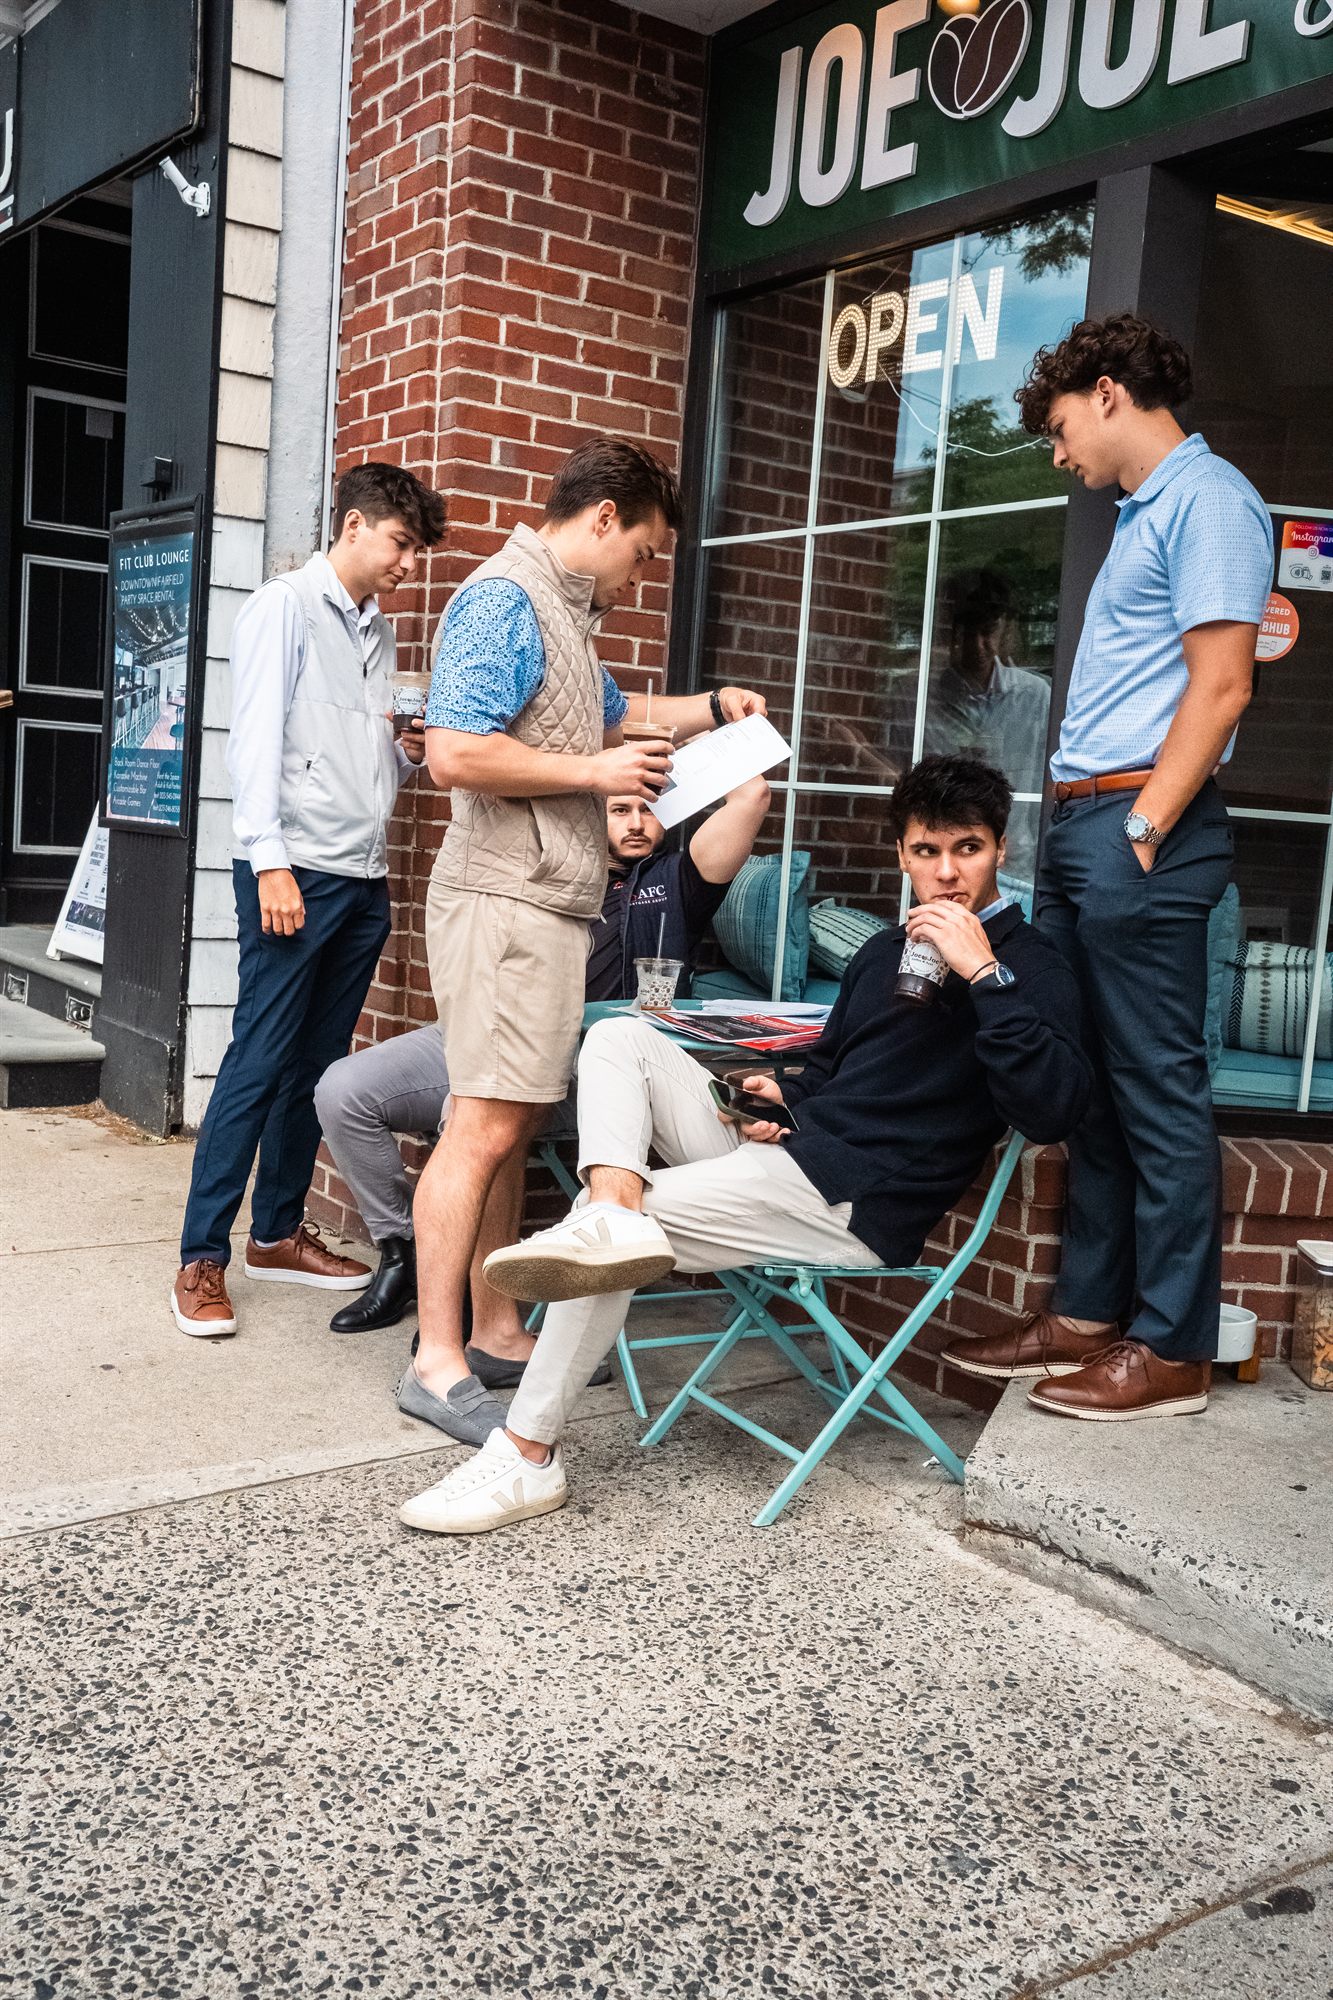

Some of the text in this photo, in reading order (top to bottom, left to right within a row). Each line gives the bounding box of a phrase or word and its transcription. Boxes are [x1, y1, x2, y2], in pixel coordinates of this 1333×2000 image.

[743, 0, 930, 227] JOE
[827, 266, 1004, 389] OPEN
[120, 549, 189, 571] FIT CLUB LOUNGE
[121, 577, 157, 591] DOWNTOWN
[137, 592, 154, 604] SPACE
[155, 590, 174, 602] RENTAL
[1259, 621, 1290, 635] BHUB
[638, 885, 666, 899] AFC
